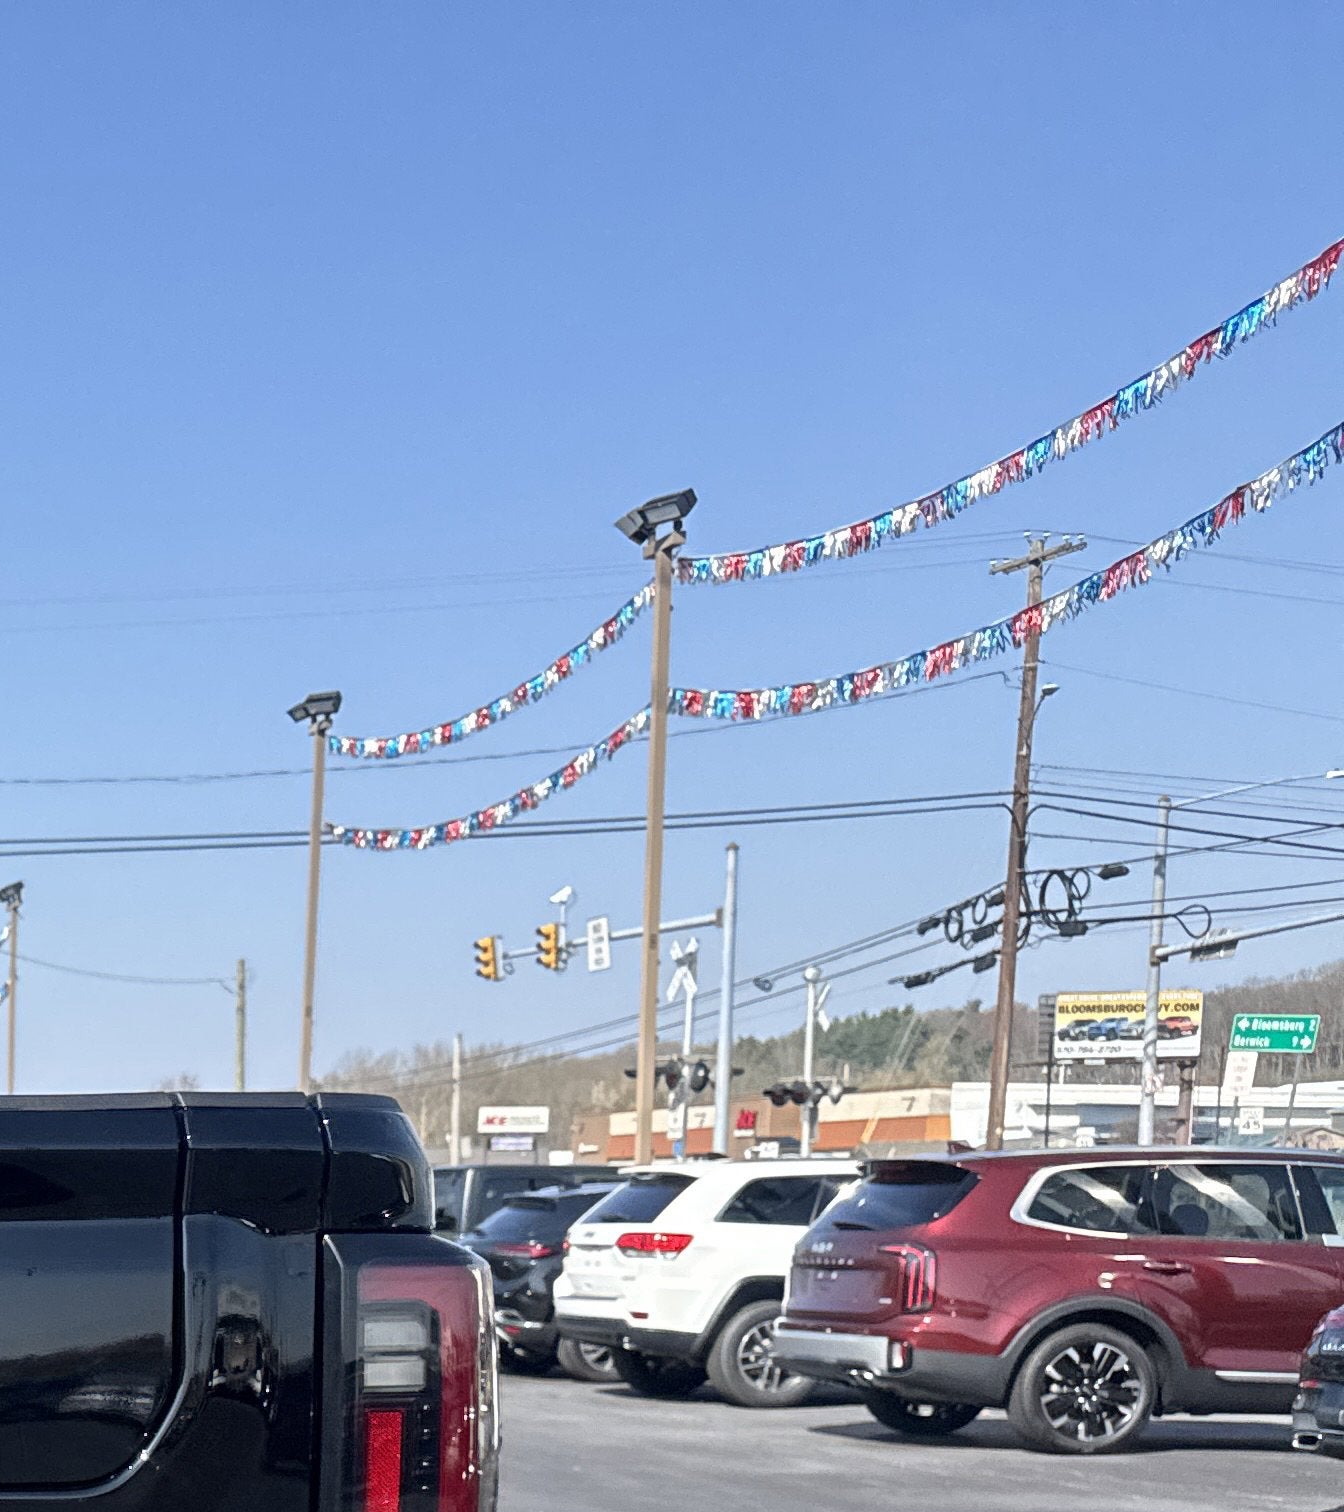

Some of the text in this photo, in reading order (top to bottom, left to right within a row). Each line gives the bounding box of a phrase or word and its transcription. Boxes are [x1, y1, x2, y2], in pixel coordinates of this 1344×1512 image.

[1058, 1002, 1200, 1014] BLOOMSBURGCHVY.COM
[1252, 1018, 1305, 1033] Bloomsburg
[1233, 1034, 1270, 1047] Berwick
